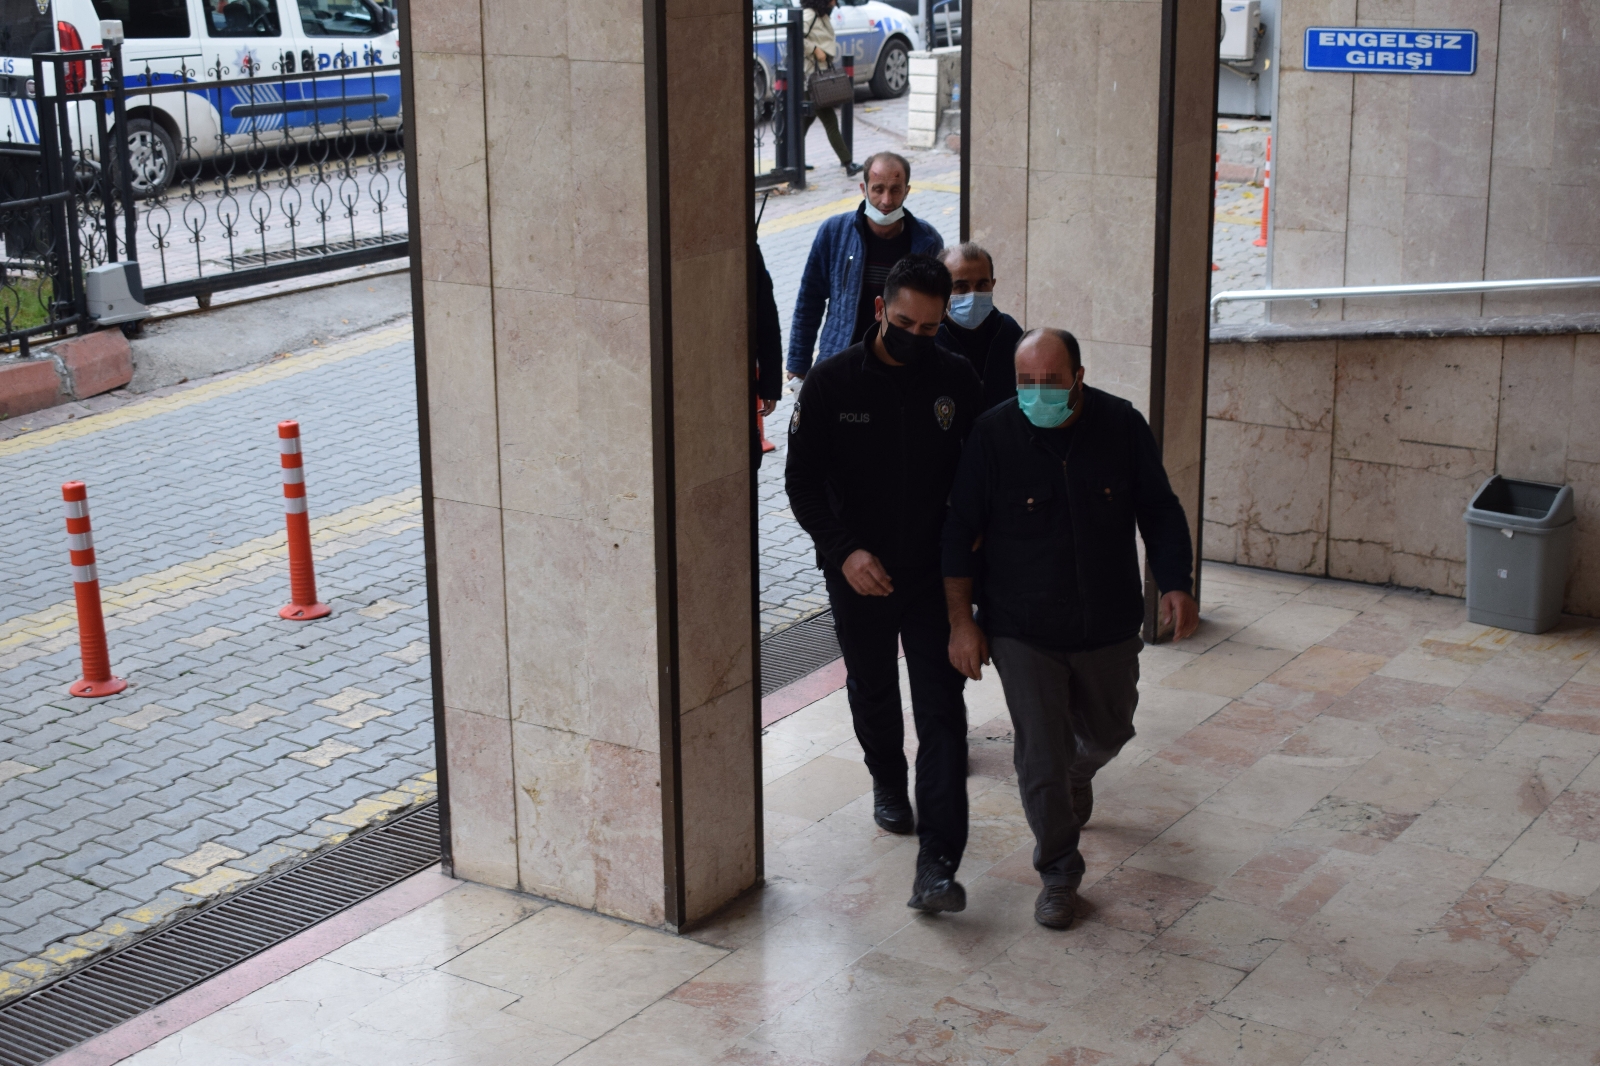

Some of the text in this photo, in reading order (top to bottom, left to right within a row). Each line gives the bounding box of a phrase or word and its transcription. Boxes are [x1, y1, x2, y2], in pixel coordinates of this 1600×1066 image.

[1319, 32, 1462, 49] ENGELSİZ
[833, 38, 864, 63] OLİS
[0, 58, 14, 74] İS
[1346, 51, 1433, 70] GİRİŞİ
